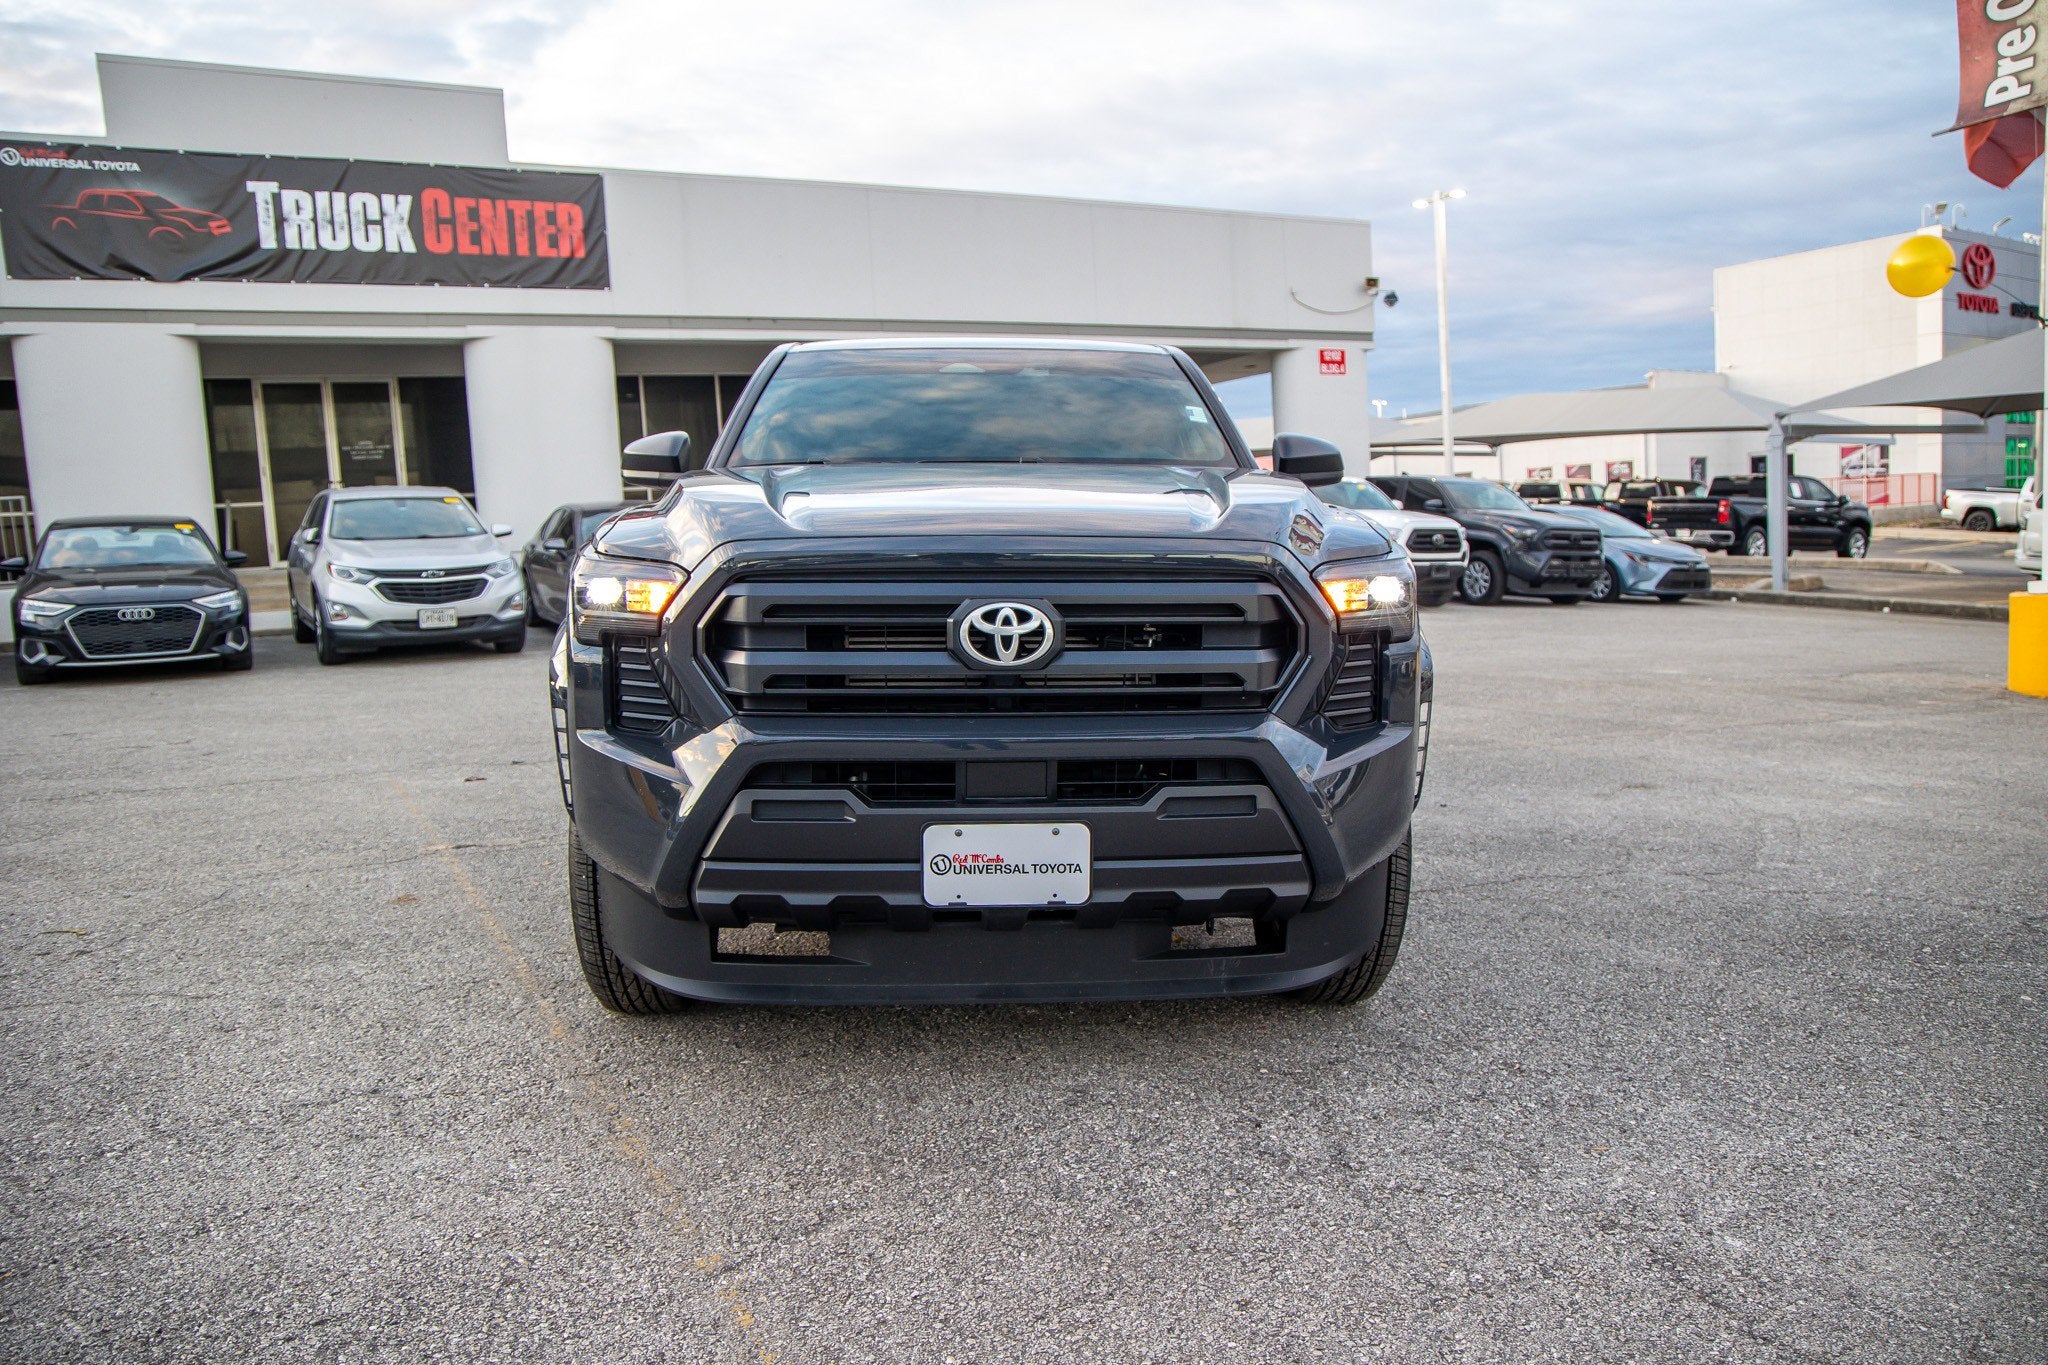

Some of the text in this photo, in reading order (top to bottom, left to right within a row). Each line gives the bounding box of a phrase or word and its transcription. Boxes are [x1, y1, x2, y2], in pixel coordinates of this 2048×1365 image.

[1984, 25, 2036, 108] Pre
[20, 157, 141, 172] UNIVERSAL TOYOTA
[246, 181, 586, 259] TRUCK CENTER
[1957, 292, 1999, 314] TOYOTA
[953, 854, 1004, 866] Red McCombs
[953, 863, 1083, 875] UNIVERSAL TOYOTA
